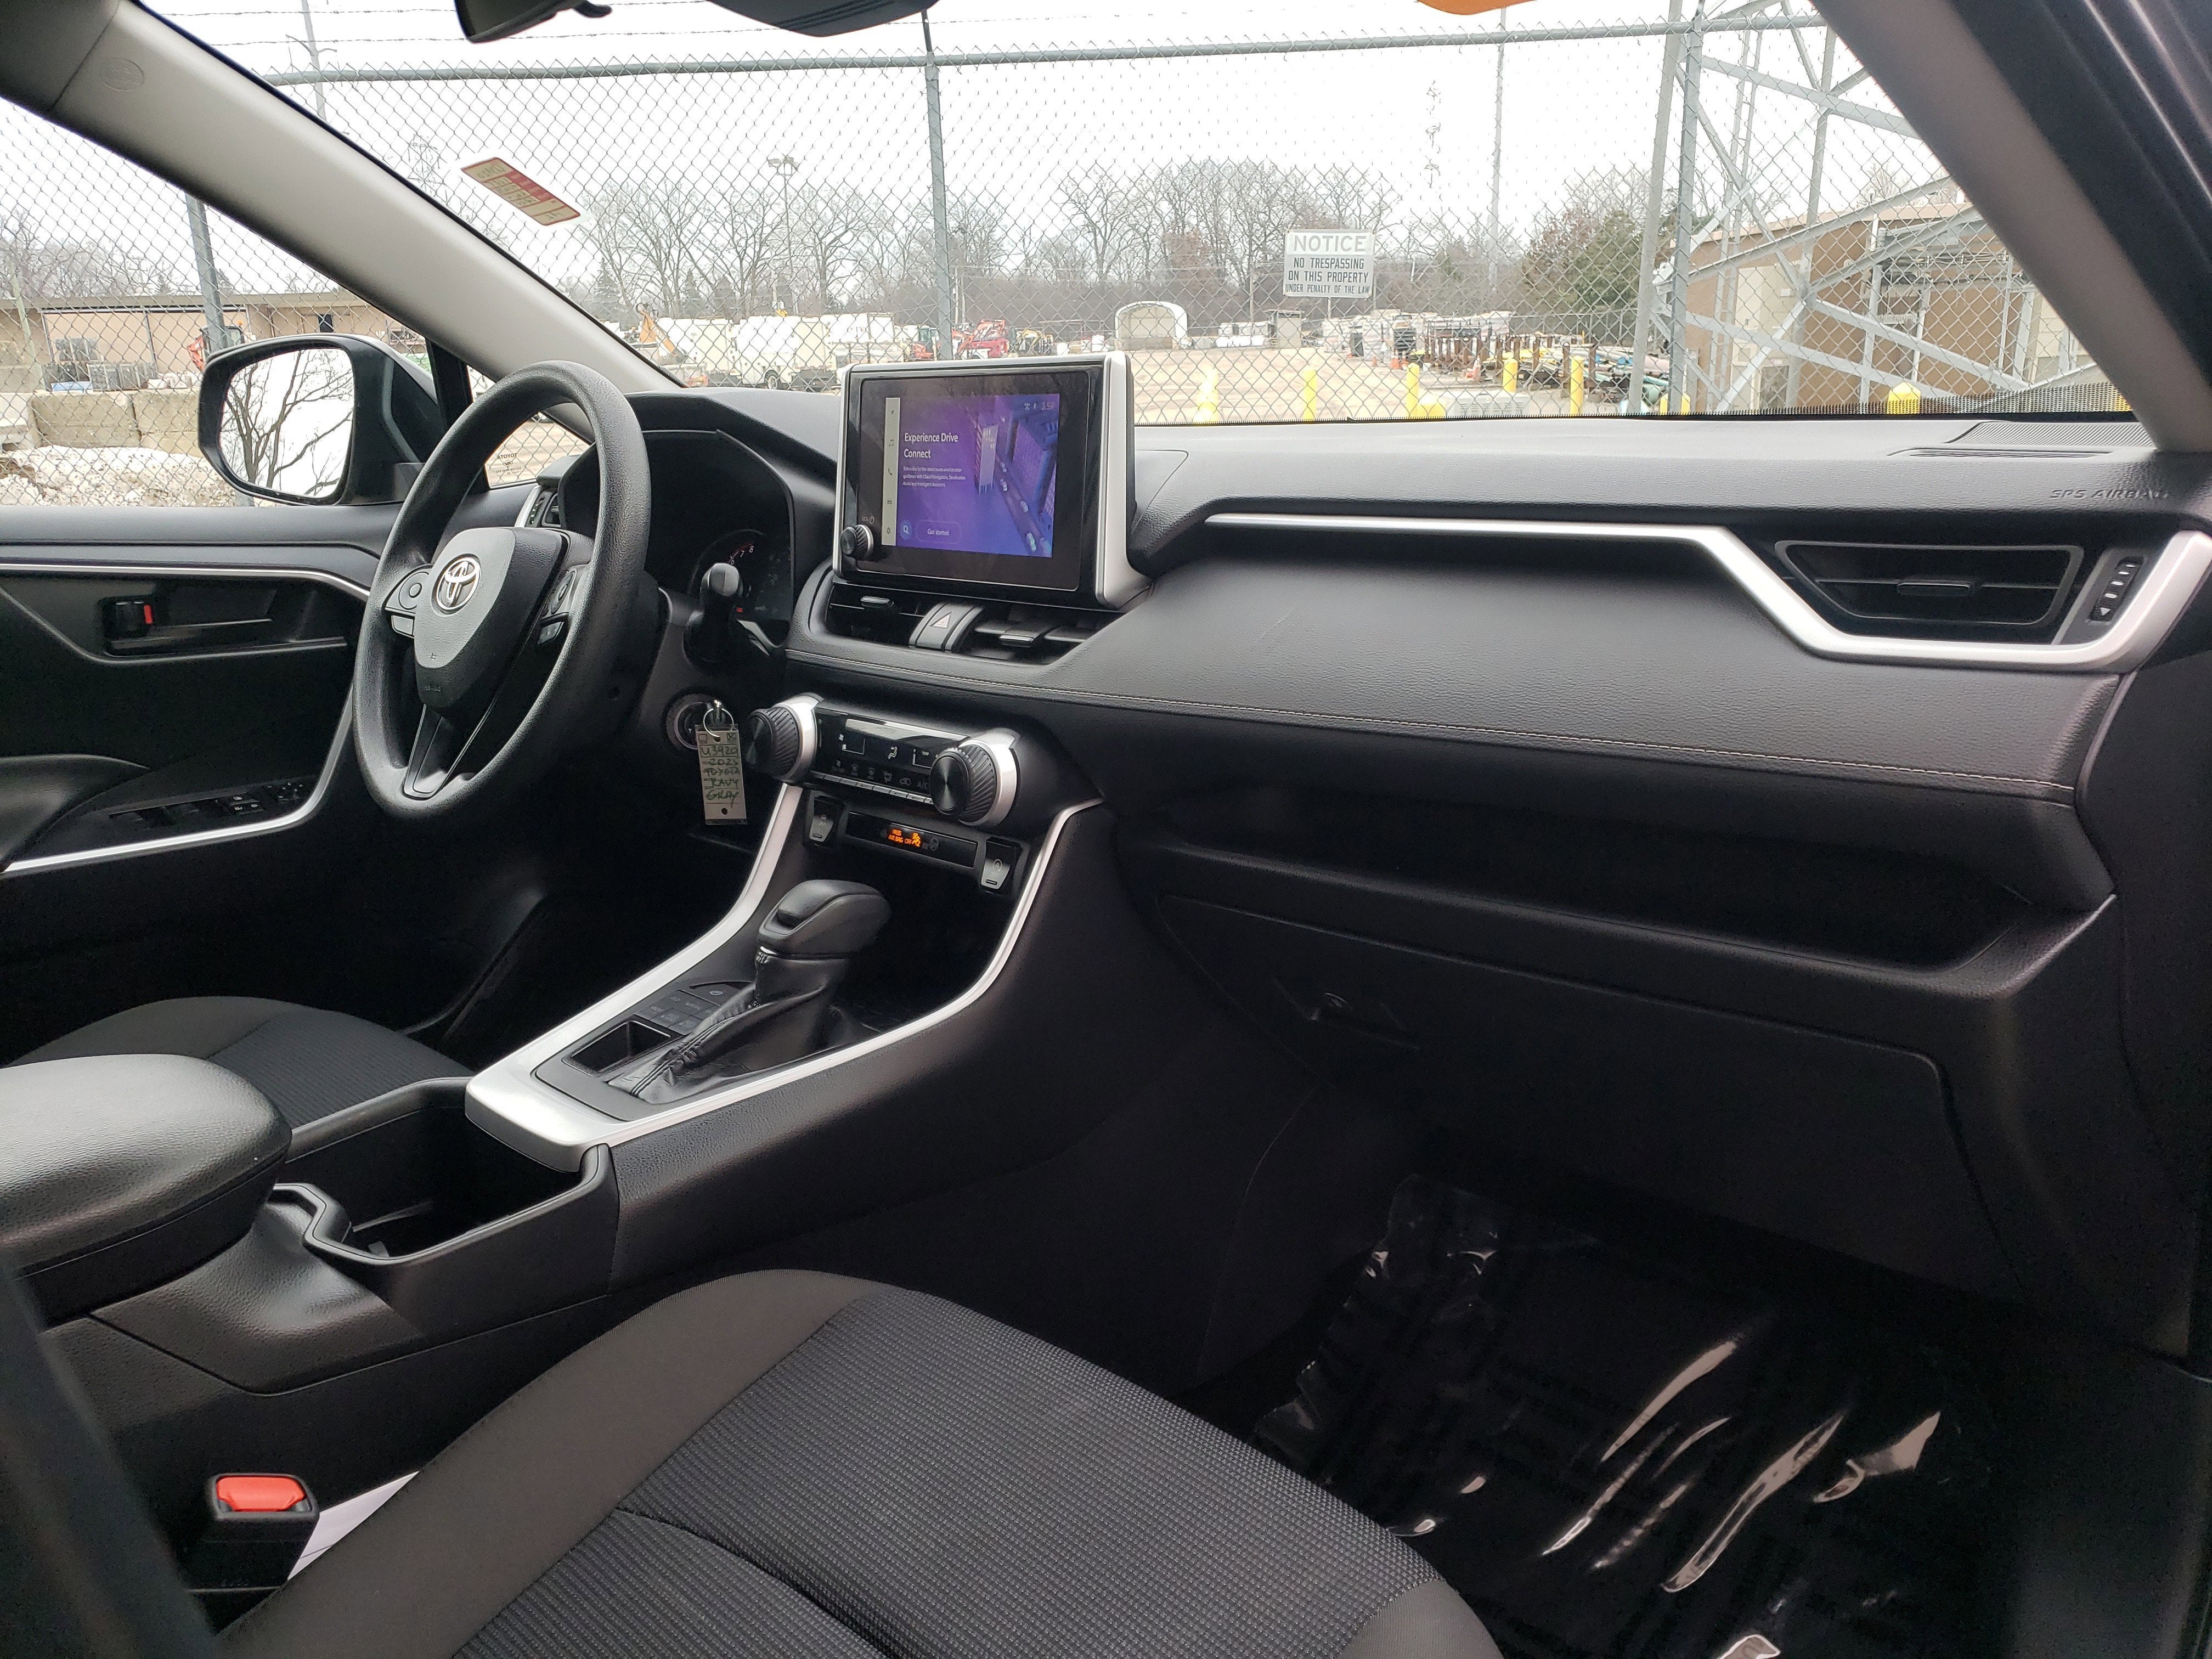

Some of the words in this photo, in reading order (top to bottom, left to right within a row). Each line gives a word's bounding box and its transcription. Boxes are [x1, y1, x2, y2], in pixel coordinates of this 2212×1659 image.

[1293, 235, 1367, 252] NOTICE
[1294, 257, 1305, 268] NO
[1310, 258, 1364, 269] TRESPASSING
[1289, 270, 1299, 281] ON
[1304, 270, 1322, 282] THIS
[1327, 272, 1369, 283] PROPERTY
[1285, 284, 1304, 292] UNDER
[1307, 284, 1331, 293] PENALTY
[1334, 285, 1341, 294] OF
[1345, 285, 1355, 294] THE
[1358, 286, 1370, 294] LAW
[904, 432, 940, 444] Experience
[941, 432, 958, 442] Drive
[904, 448, 931, 459] Connect
[710, 758, 738, 766] 2025
